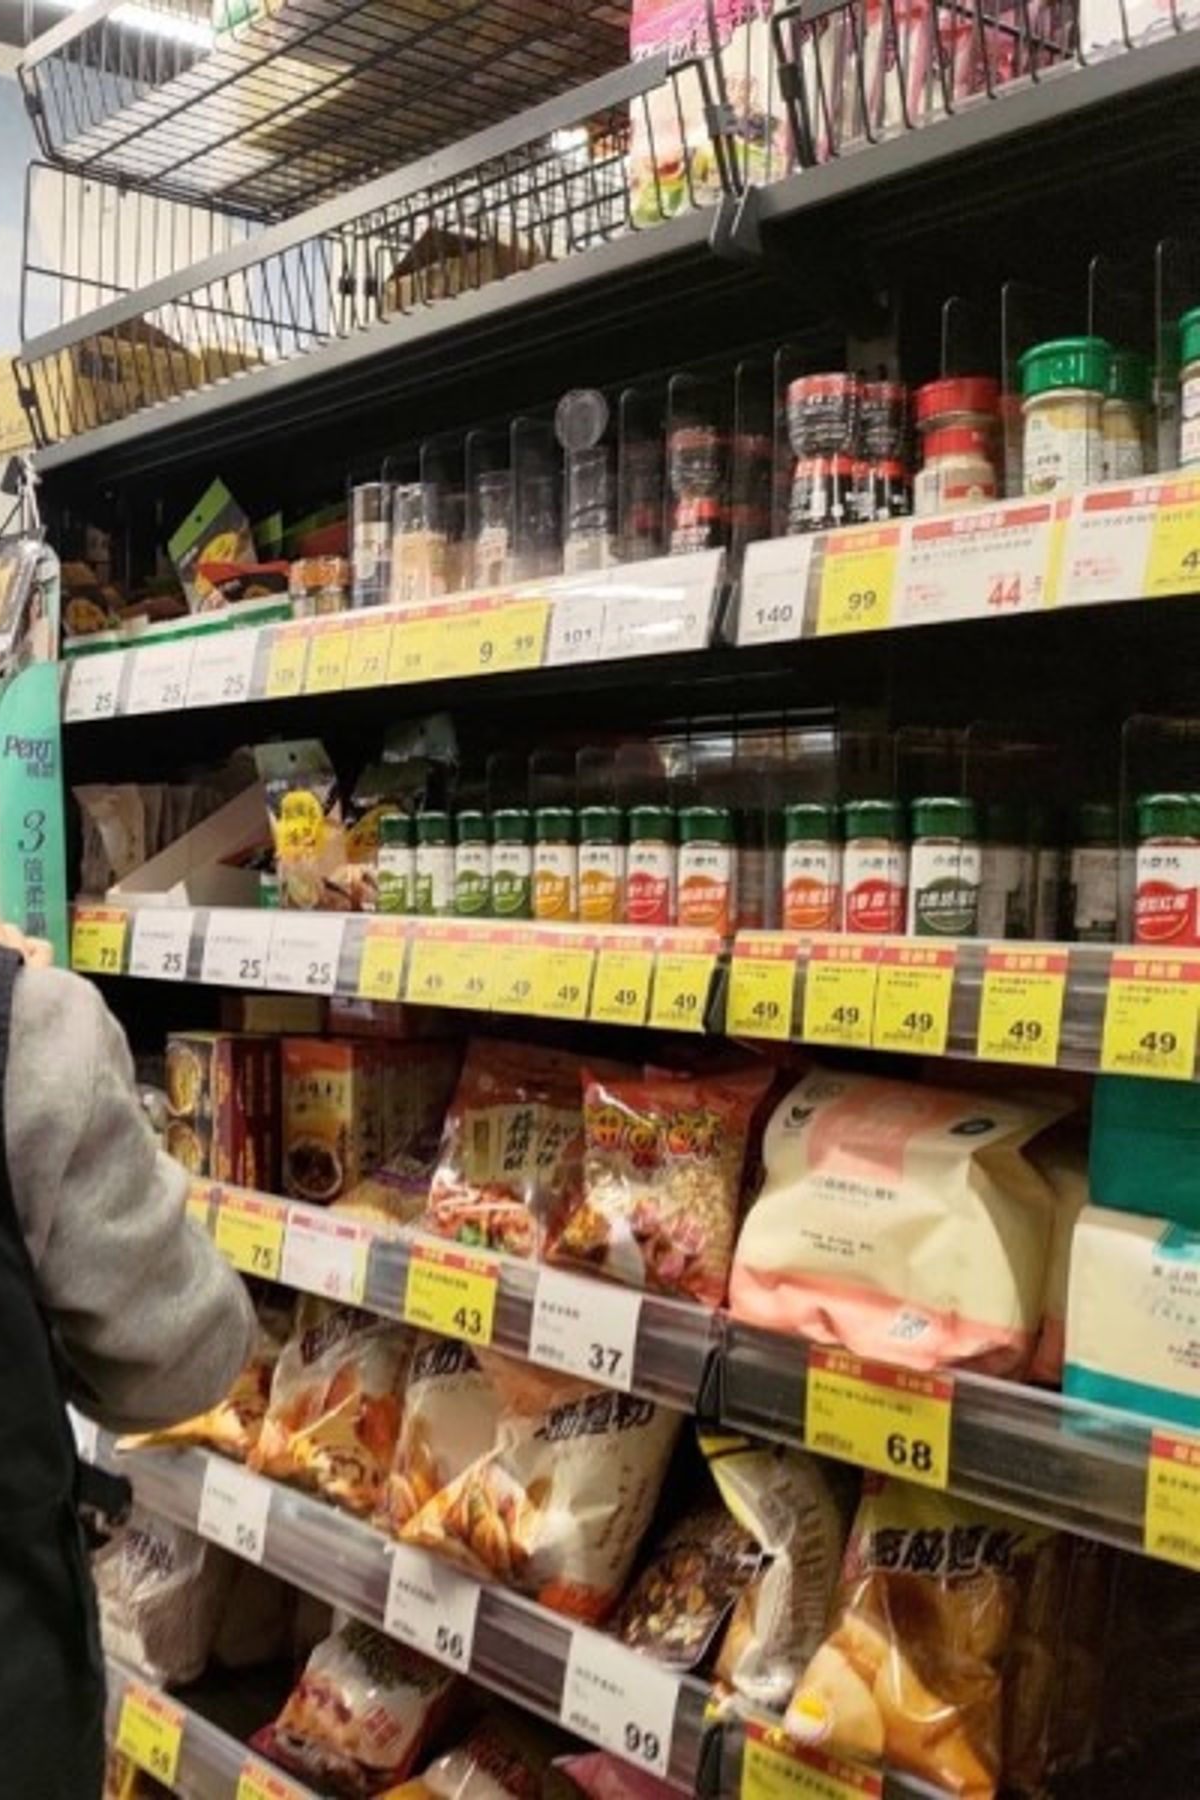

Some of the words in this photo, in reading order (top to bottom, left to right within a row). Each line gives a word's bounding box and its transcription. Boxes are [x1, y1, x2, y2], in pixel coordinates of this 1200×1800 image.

[847, 589, 878, 612] 99
[987, 573, 1022, 606] 44
[755, 603, 794, 625] 140
[161, 684, 181, 703] 25
[222, 674, 245, 696] 25
[94, 692, 113, 712] 25
[163, 951, 182, 973] 25
[238, 958, 261, 980] 25
[306, 962, 330, 985] 25
[557, 984, 579, 1003] 49
[614, 987, 637, 1007] 49
[673, 992, 697, 1011] 49
[751, 1001, 780, 1021] 49
[831, 1006, 860, 1025] 49
[903, 1012, 933, 1033] 49
[1008, 1020, 1043, 1042] 49
[1139, 1031, 1177, 1054] 49
[251, 1243, 272, 1270] 75
[453, 1306, 482, 1335] 43
[588, 1343, 623, 1376] 37
[886, 1432, 932, 1472] 68
[434, 1625, 464, 1660] 56
[625, 1721, 659, 1761] 99
